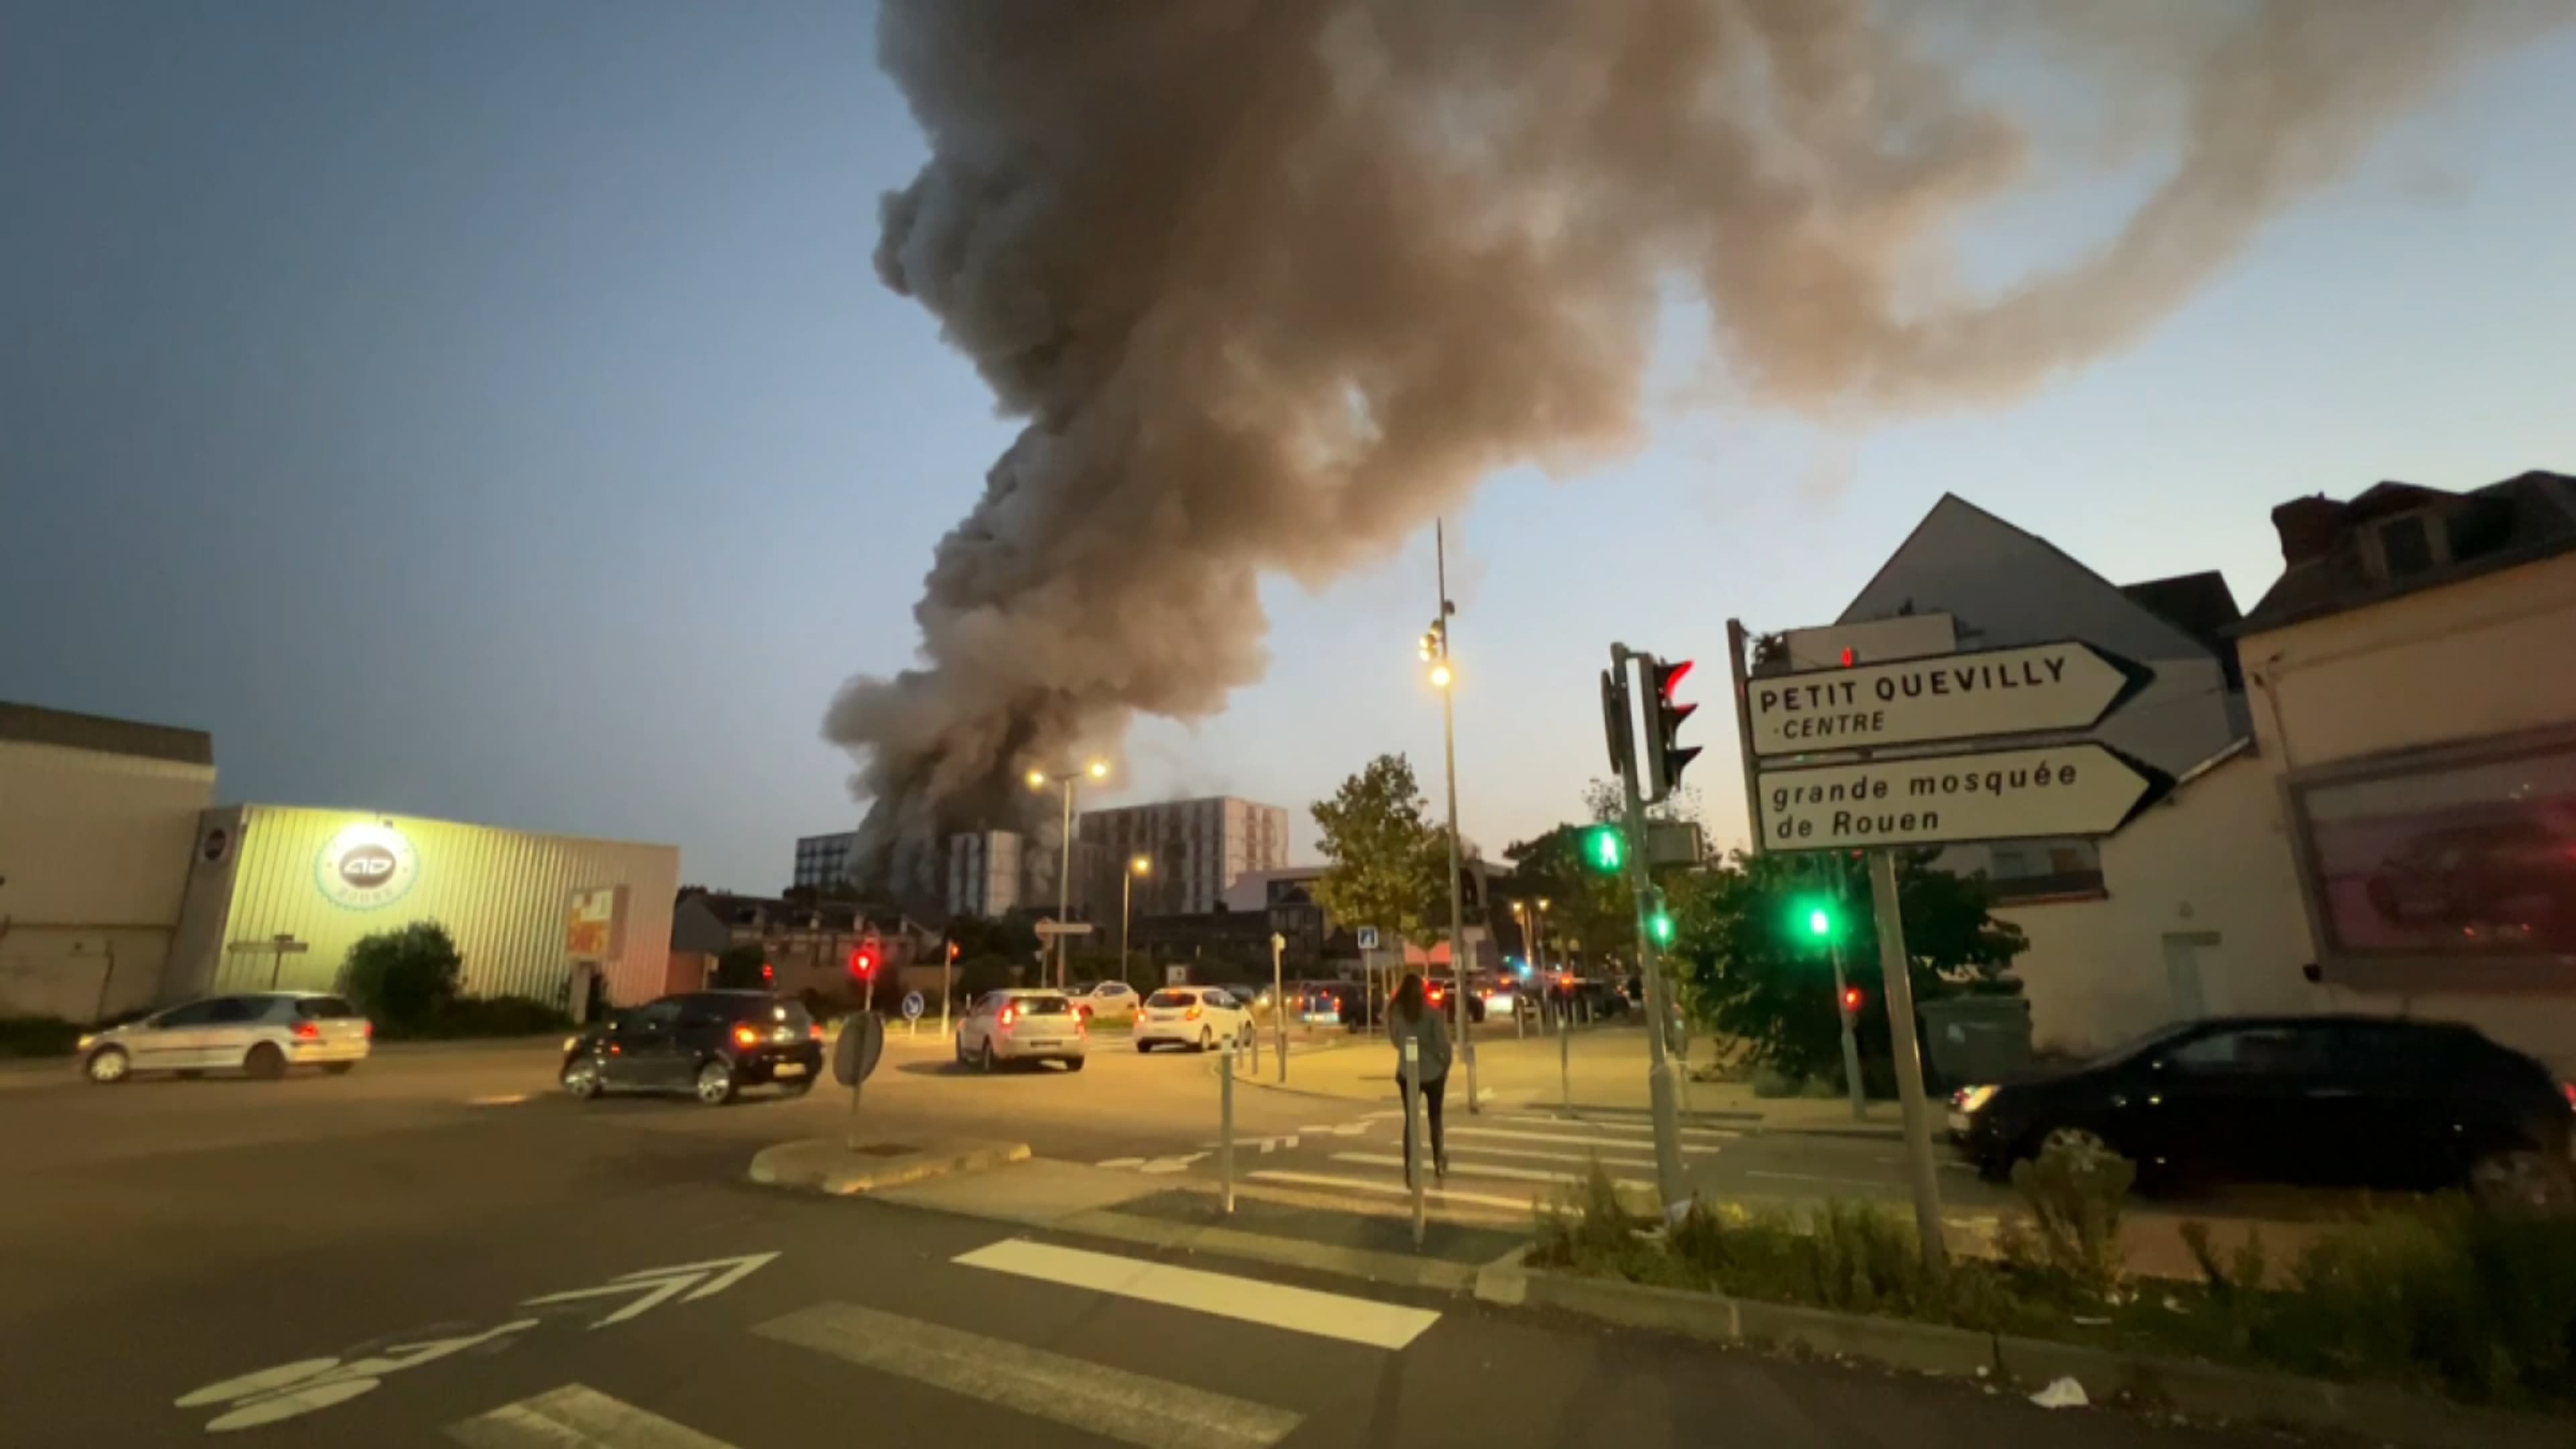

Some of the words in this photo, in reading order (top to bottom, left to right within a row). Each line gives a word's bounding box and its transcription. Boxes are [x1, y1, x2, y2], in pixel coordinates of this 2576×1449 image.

[1760, 682, 1856, 712] PETIT
[1875, 657, 2065, 702] QUEVILLY
[1773, 776, 1888, 812] grande
[1911, 761, 2077, 796] mosquée
[1777, 814, 1813, 839] de
[1833, 810, 1939, 836] Rouen
